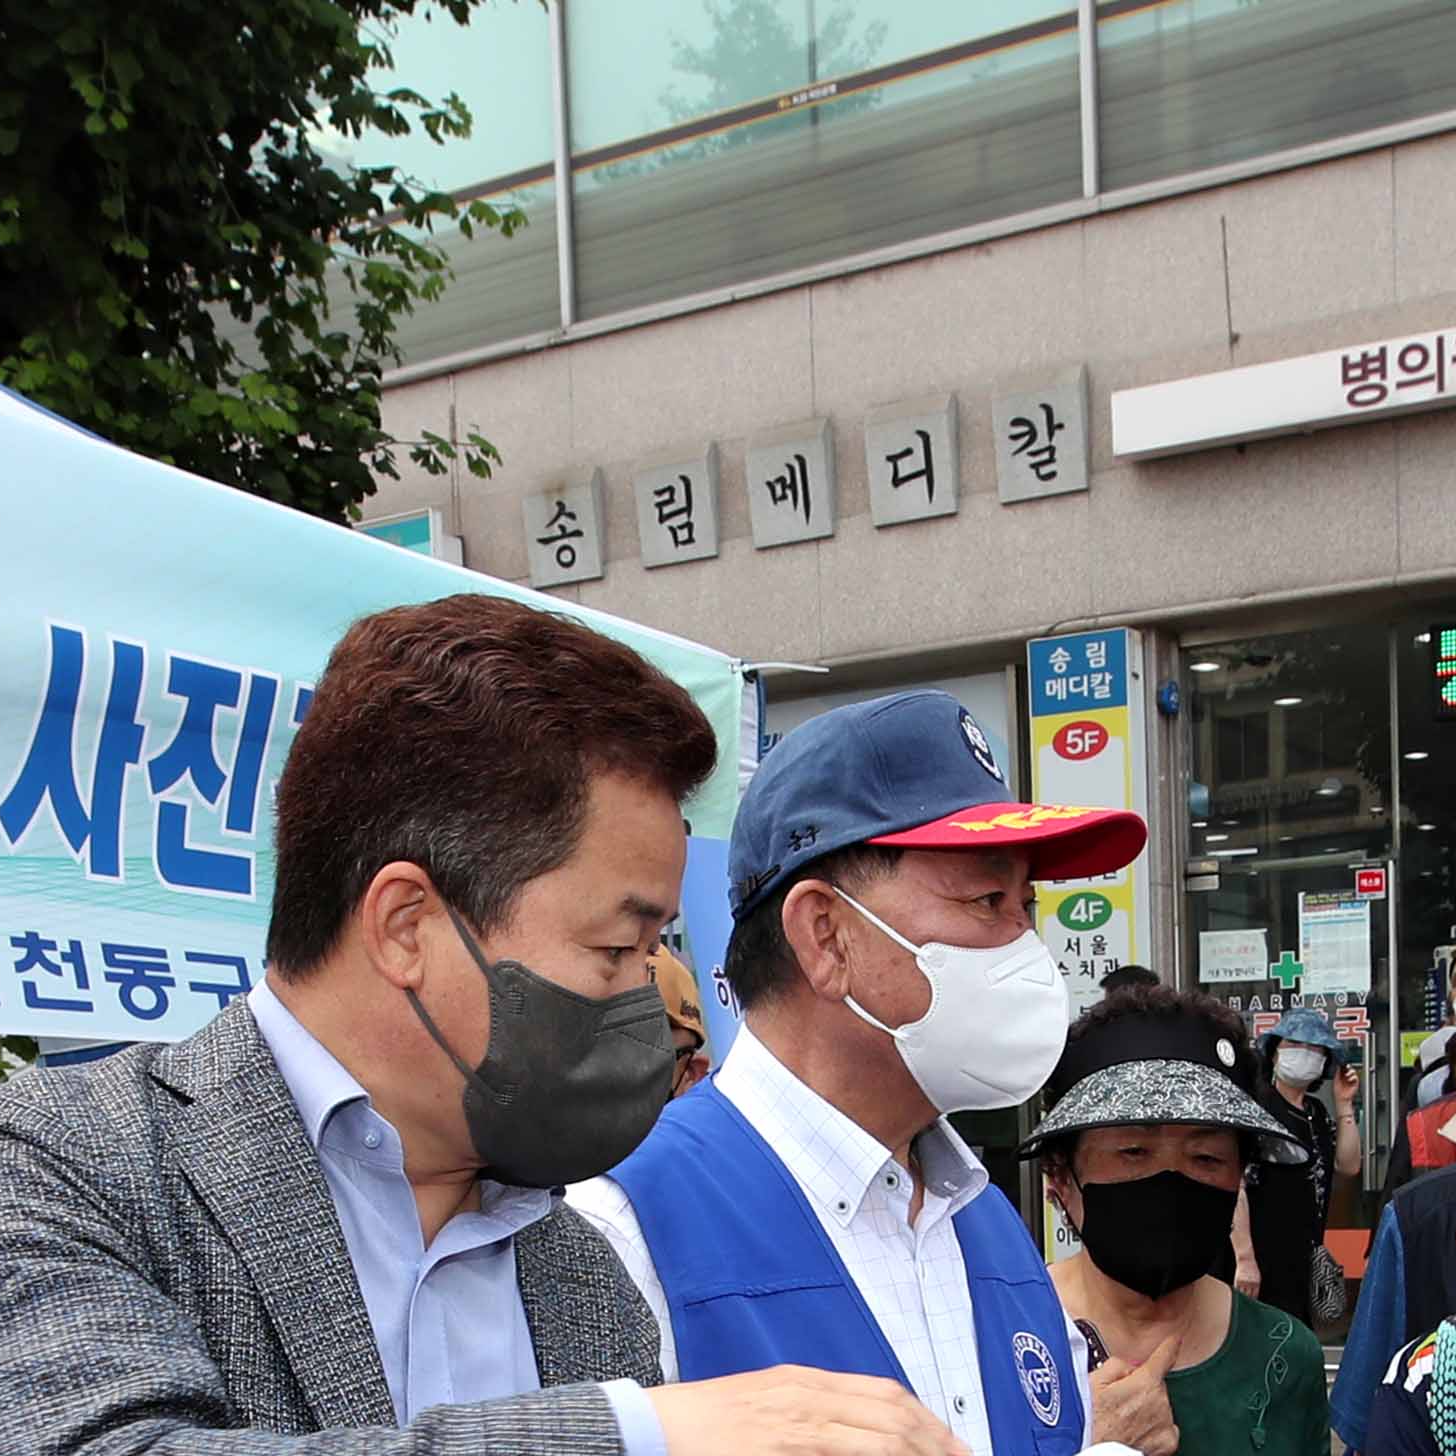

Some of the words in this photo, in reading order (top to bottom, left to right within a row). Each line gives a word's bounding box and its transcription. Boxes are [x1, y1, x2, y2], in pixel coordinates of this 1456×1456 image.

[1045, 671, 1113, 701] 메디칼
[1064, 728, 1099, 755] 5F
[1069, 897, 1104, 923] 4F
[1214, 991, 1369, 1011] HARMACY
